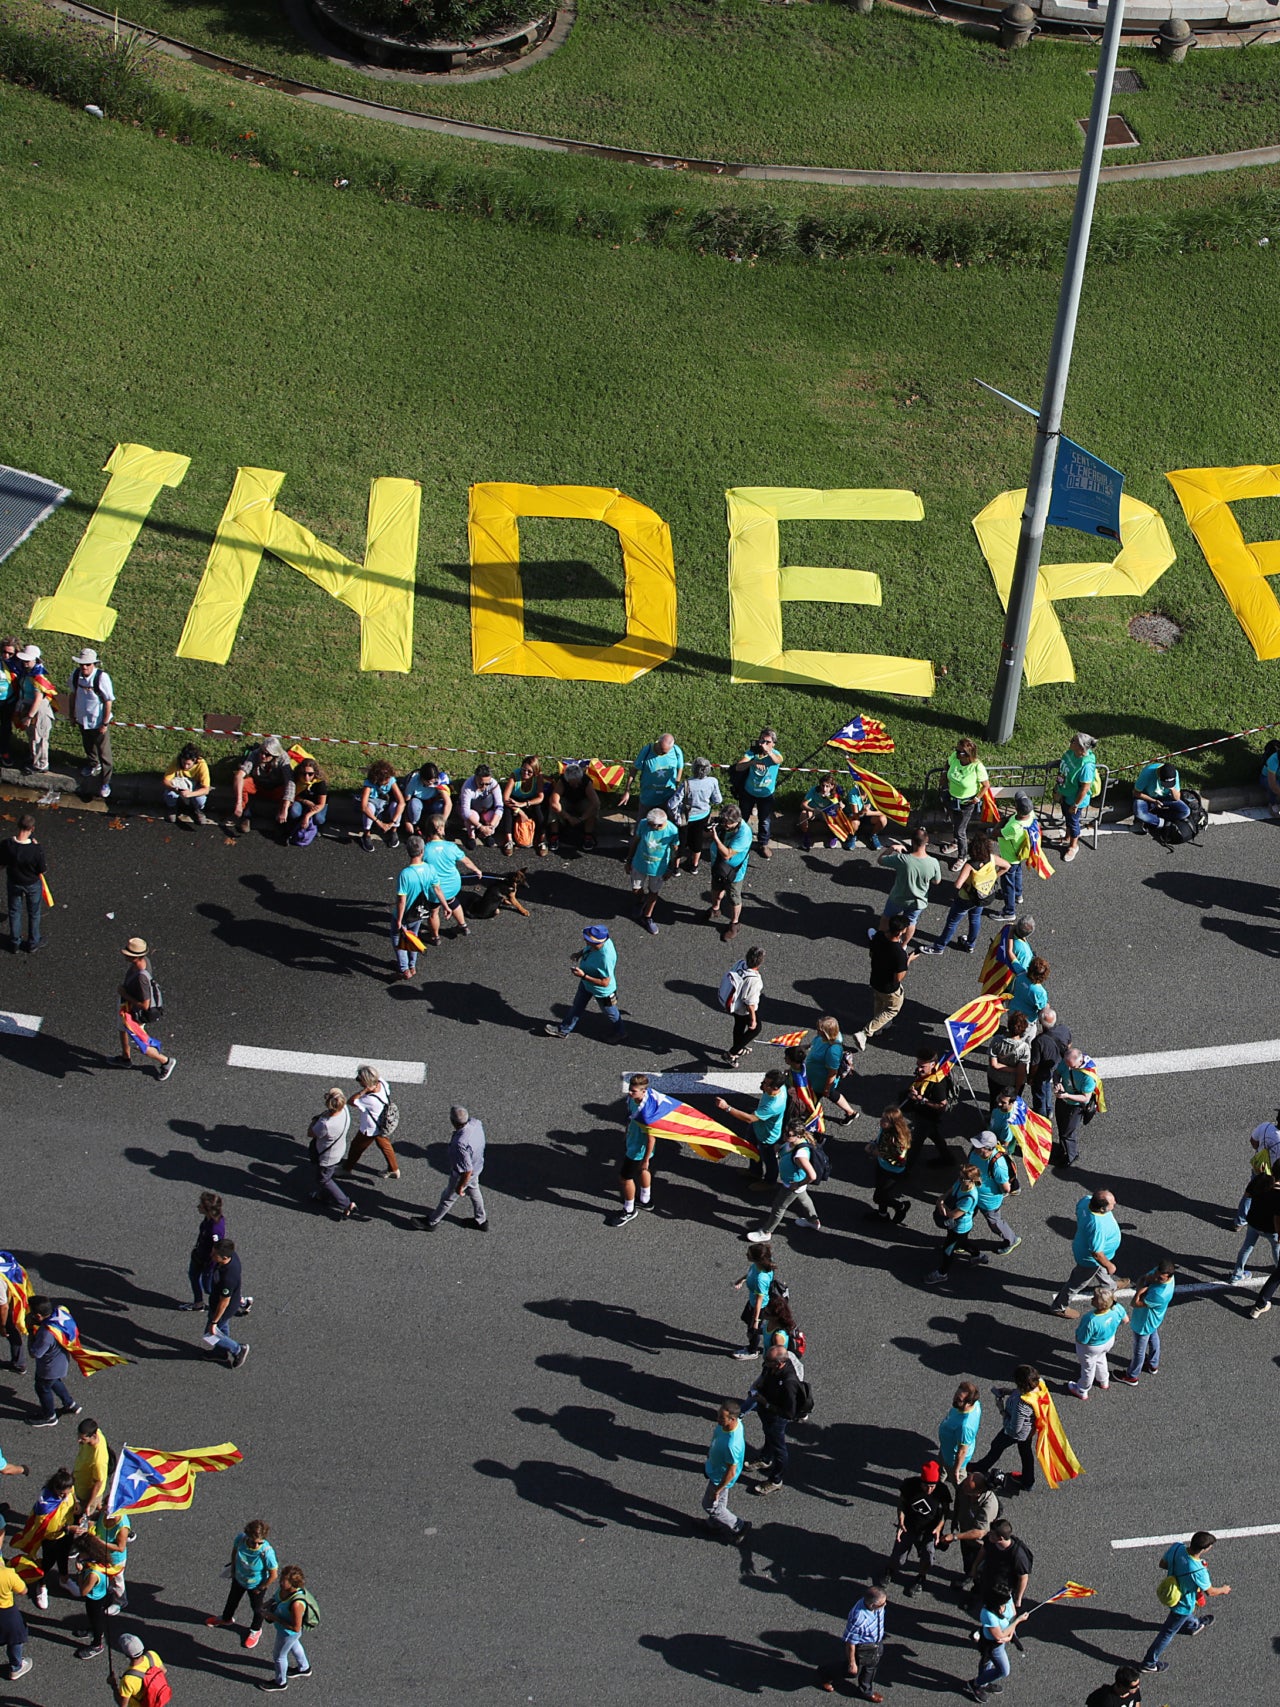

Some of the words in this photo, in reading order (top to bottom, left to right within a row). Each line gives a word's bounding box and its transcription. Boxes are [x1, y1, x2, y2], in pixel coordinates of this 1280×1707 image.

[1071, 451, 1090, 467] SENT
[1067, 474, 1084, 489] DEL
[1069, 463, 1108, 486] L'ENERGIA
